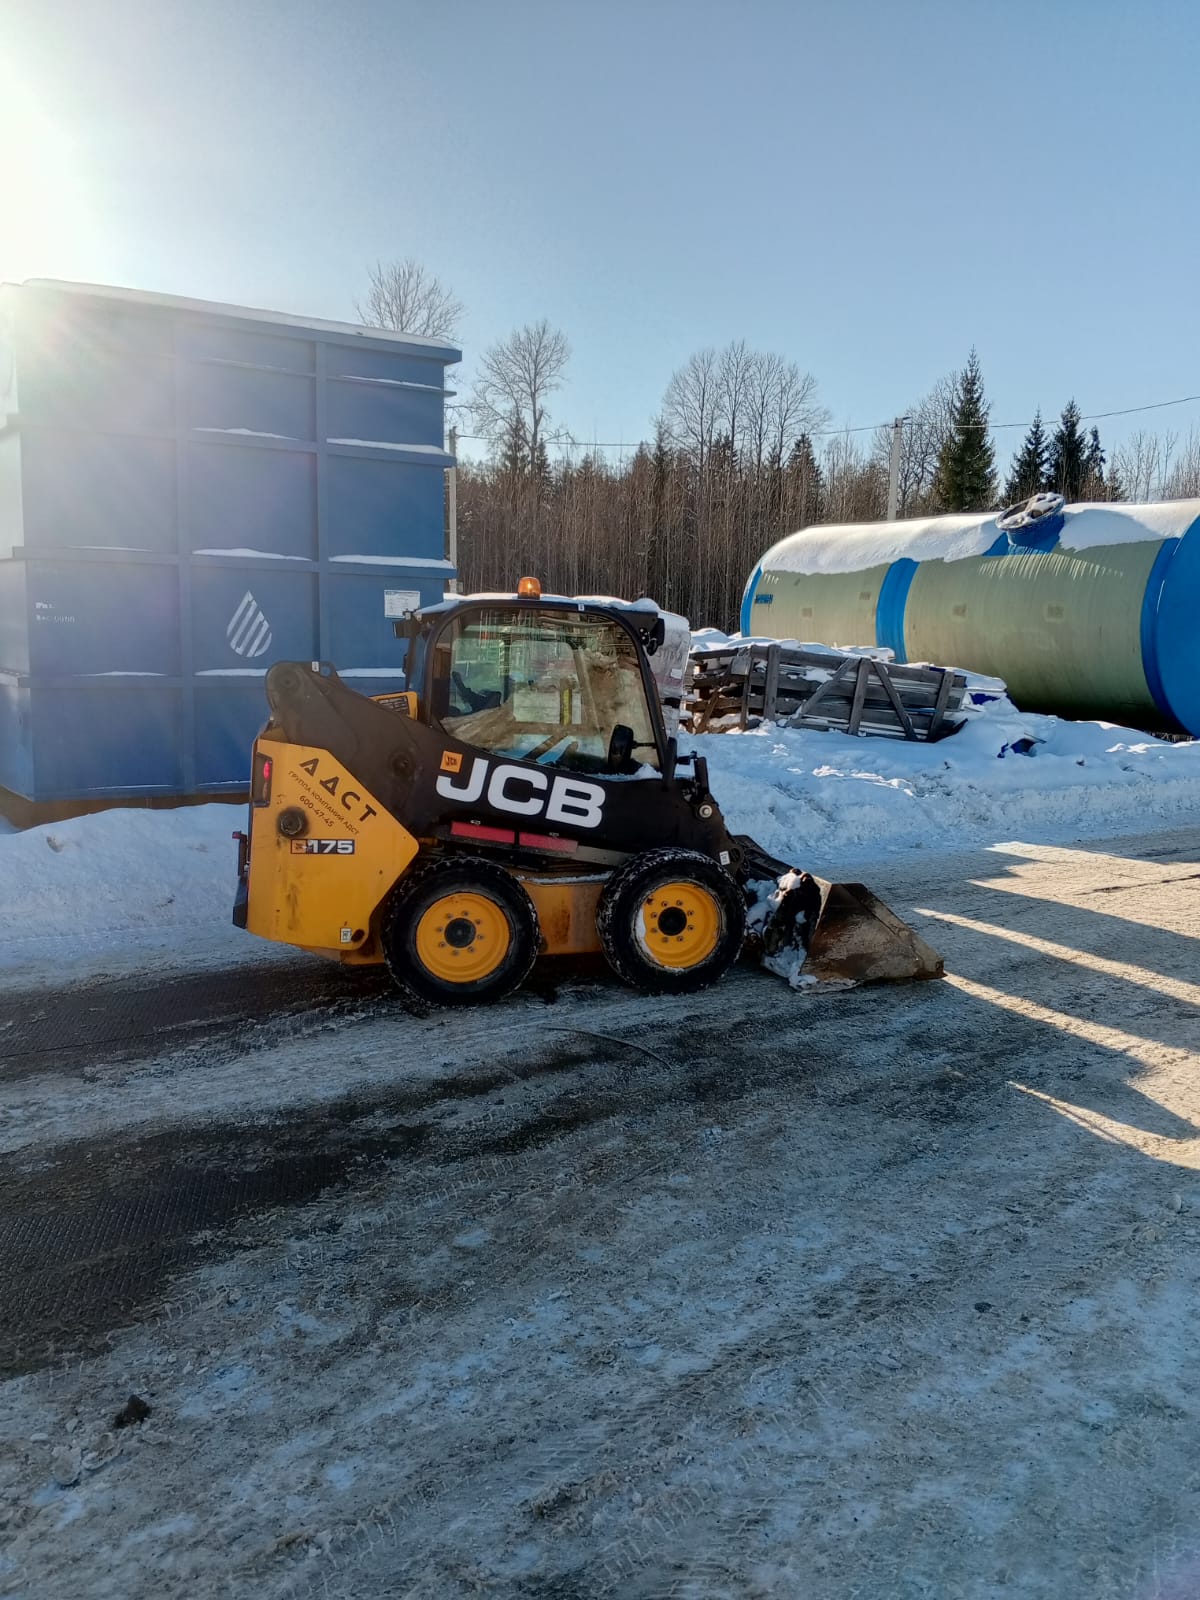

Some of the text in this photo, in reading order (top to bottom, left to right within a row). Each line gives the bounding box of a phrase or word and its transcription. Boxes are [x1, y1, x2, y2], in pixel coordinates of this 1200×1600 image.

[288, 770, 360, 836] ГРУППА КОМПАНИЙ АДСТ
[299, 758, 377, 822] АДСТ
[299, 795, 334, 828] 600-47-45
[436, 757, 606, 828] JCB
[307, 840, 353, 854] 175
